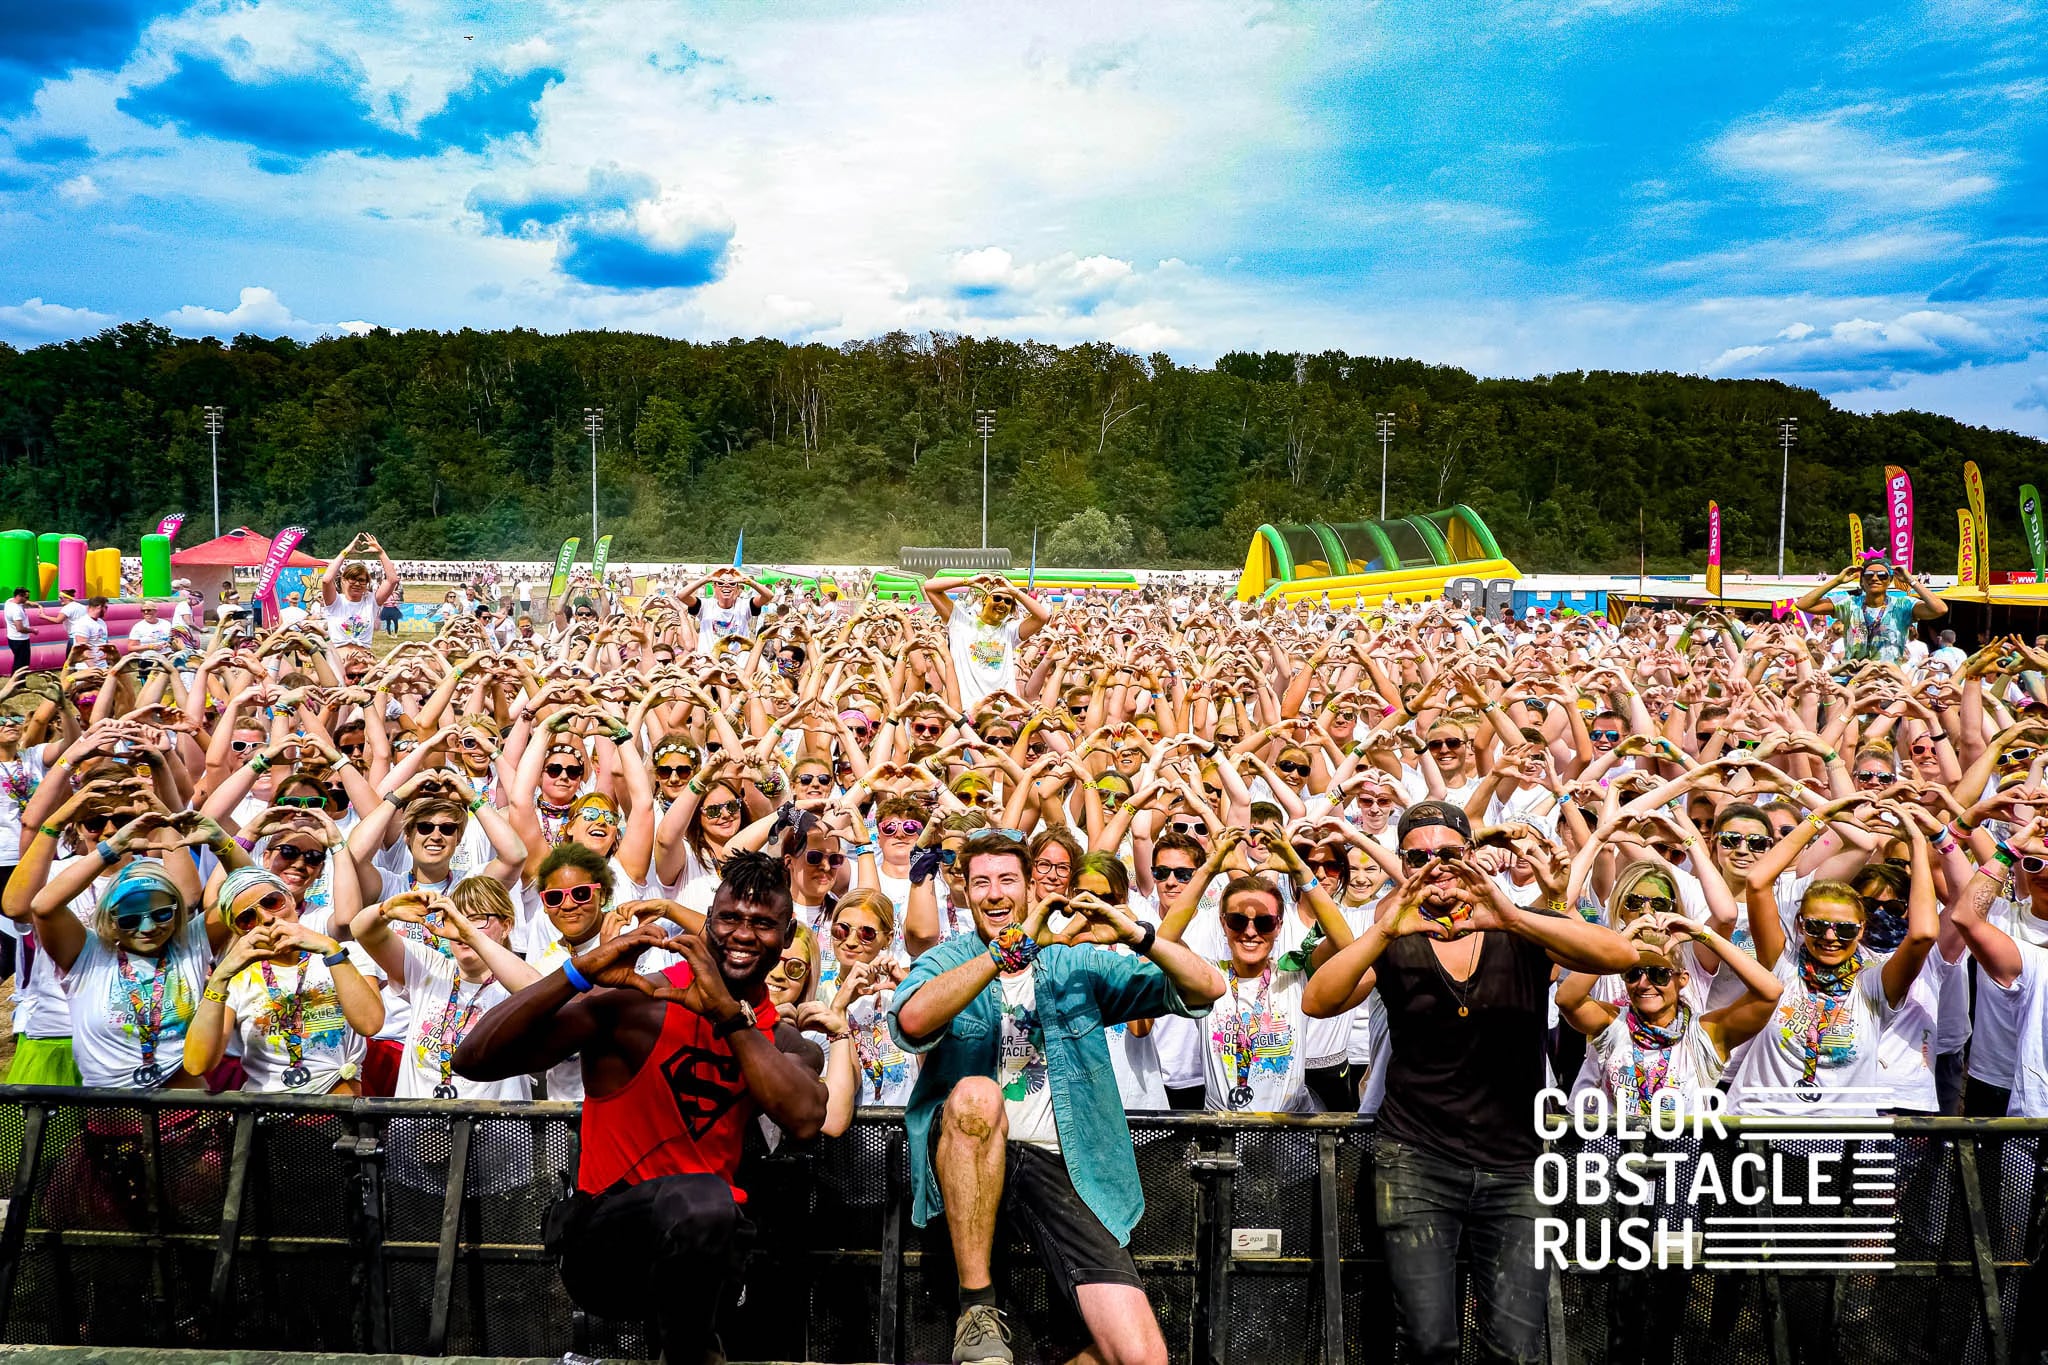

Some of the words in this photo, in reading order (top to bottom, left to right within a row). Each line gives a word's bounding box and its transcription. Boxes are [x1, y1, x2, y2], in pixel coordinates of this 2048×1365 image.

[1892, 476, 1908, 528] BAGS
[1709, 511, 1718, 556] STORE
[560, 545, 573, 573] START
[595, 543, 607, 571] START
[1962, 517, 1973, 582] CHECK-IN
[256, 558, 279, 597] FINISH
[273, 532, 297, 559] LINE
[1785, 1019, 1808, 1040] RUS
[420, 1036, 441, 1054] RUS
[1002, 1046, 1032, 1058] TACLE
[1611, 1071, 1639, 1089] COLO
